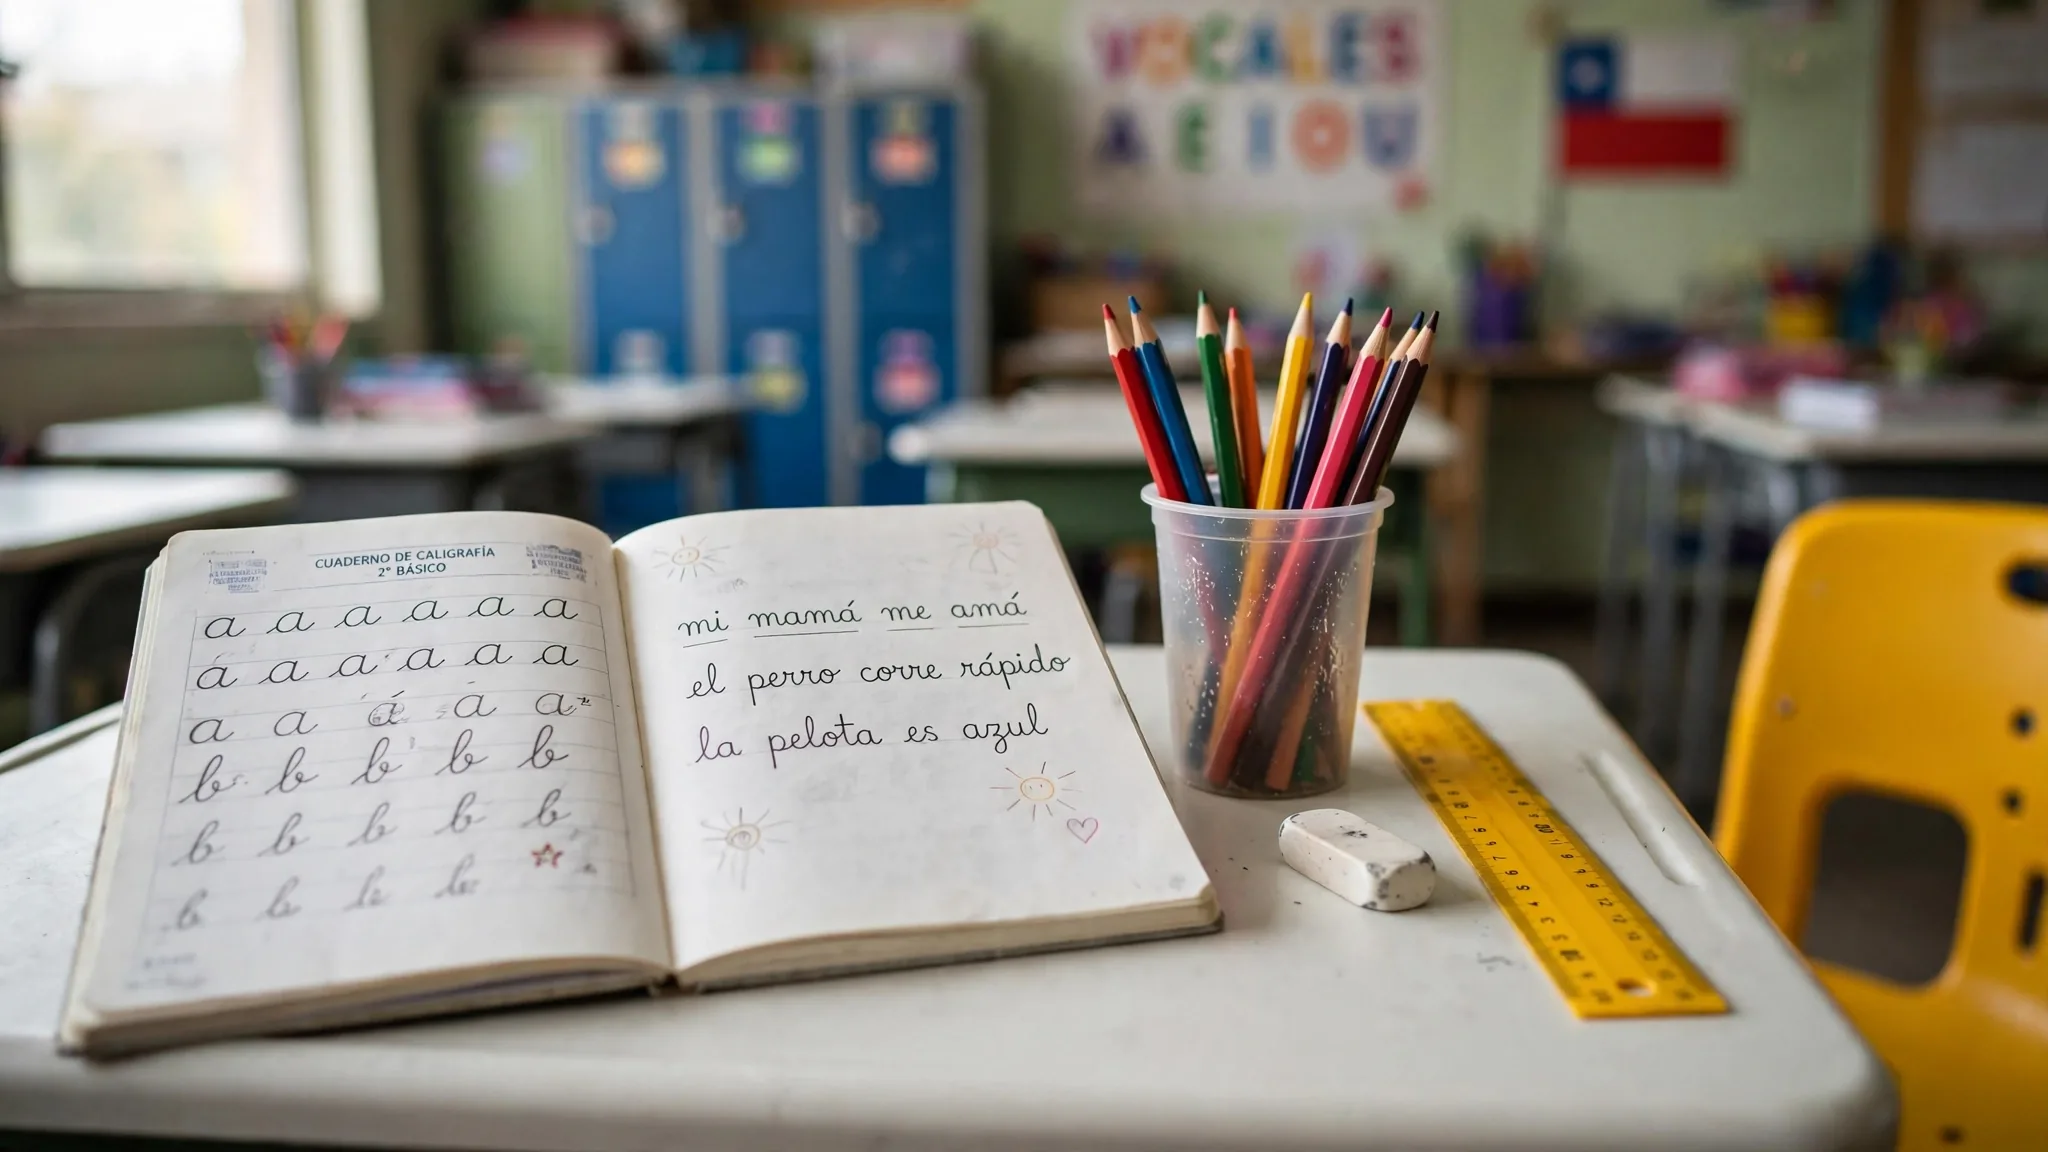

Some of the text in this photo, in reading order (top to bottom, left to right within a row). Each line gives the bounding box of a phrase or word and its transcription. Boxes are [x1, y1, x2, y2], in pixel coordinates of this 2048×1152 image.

[1090, 12, 1418, 86] VOCALES
[315, 545, 496, 569] CUADERNO DE CALIGRAFÍA
[396, 562, 446, 576] BÁSICO
[205, 596, 578, 639] a a a a a a
[678, 591, 1027, 637] mi mamá me amá
[258, 660, 309, 684] áaaaaa
[329, 654, 378, 678] áaaaaa
[397, 648, 445, 671] áaaaaa
[465, 644, 512, 665] áaaaaa
[533, 644, 578, 666] áaaaaa
[687, 643, 1071, 706] el perro corre rápido
[189, 719, 234, 744] a
[274, 711, 318, 736] a
[695, 703, 1049, 769] la pelota es azul
[179, 724, 568, 803] b b b b b
